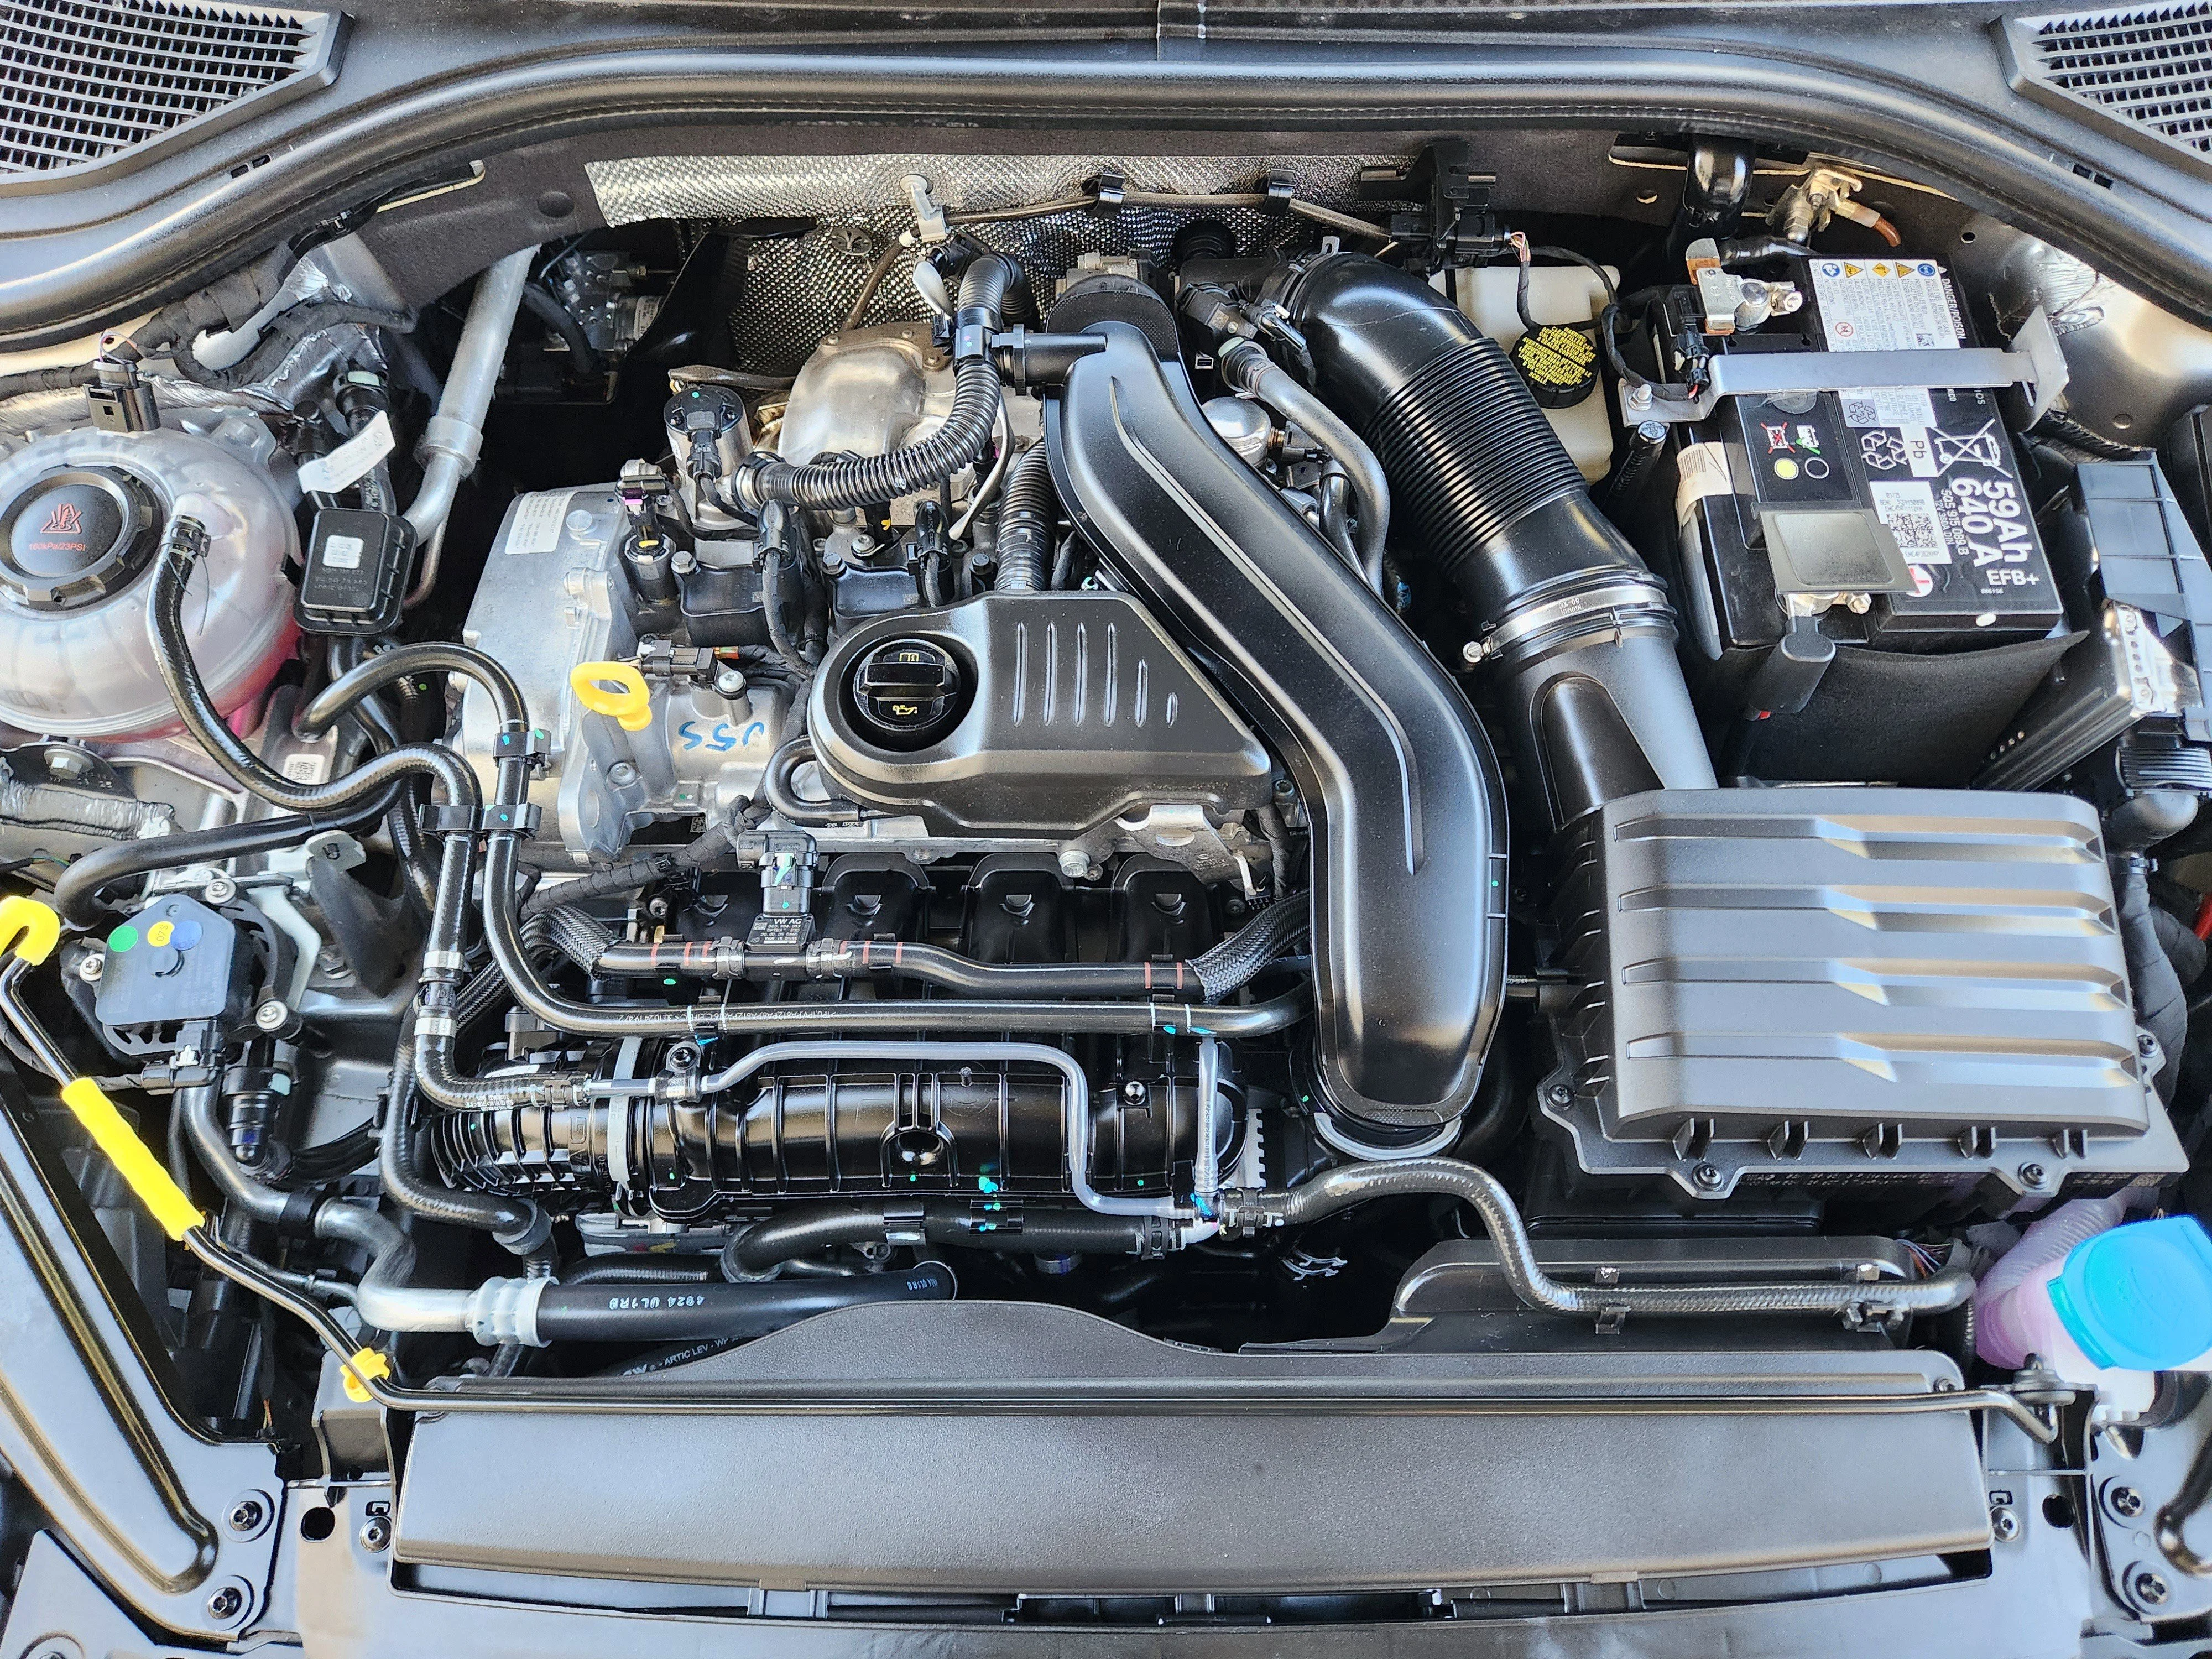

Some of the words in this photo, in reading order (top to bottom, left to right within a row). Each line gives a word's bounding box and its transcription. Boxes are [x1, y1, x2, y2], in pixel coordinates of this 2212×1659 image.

[1942, 278, 1966, 340] DANGER/POISON
[1542, 327, 1561, 340] BEFORE
[1538, 331, 1552, 341] ONLY
[1551, 338, 1562, 346] DOT
[1564, 345, 1579, 356] FLUID
[1578, 353, 1592, 363] FROM
[1540, 338, 1559, 351] SEALED
[1567, 335, 1583, 346] FILLER
[1582, 343, 1593, 351] CAP
[1911, 440, 1925, 460] Pb
[1935, 500, 1945, 512] 12V
[1940, 489, 1956, 509] 5QS
[1952, 479, 1994, 534] 640
[1938, 512, 1951, 530] 380A
[1946, 510, 1961, 527] 915
[1983, 480, 2032, 562] 59Ah
[1943, 531, 1955, 545] DIN
[1951, 527, 1966, 546] 089
[29, 542, 86, 552] 160kPa/23PSI
[1968, 541, 2004, 567] A
[1986, 569, 2039, 587] EFB+
[664, 1350, 691, 1366] ARTIC
[692, 1343, 708, 1355] LEV
